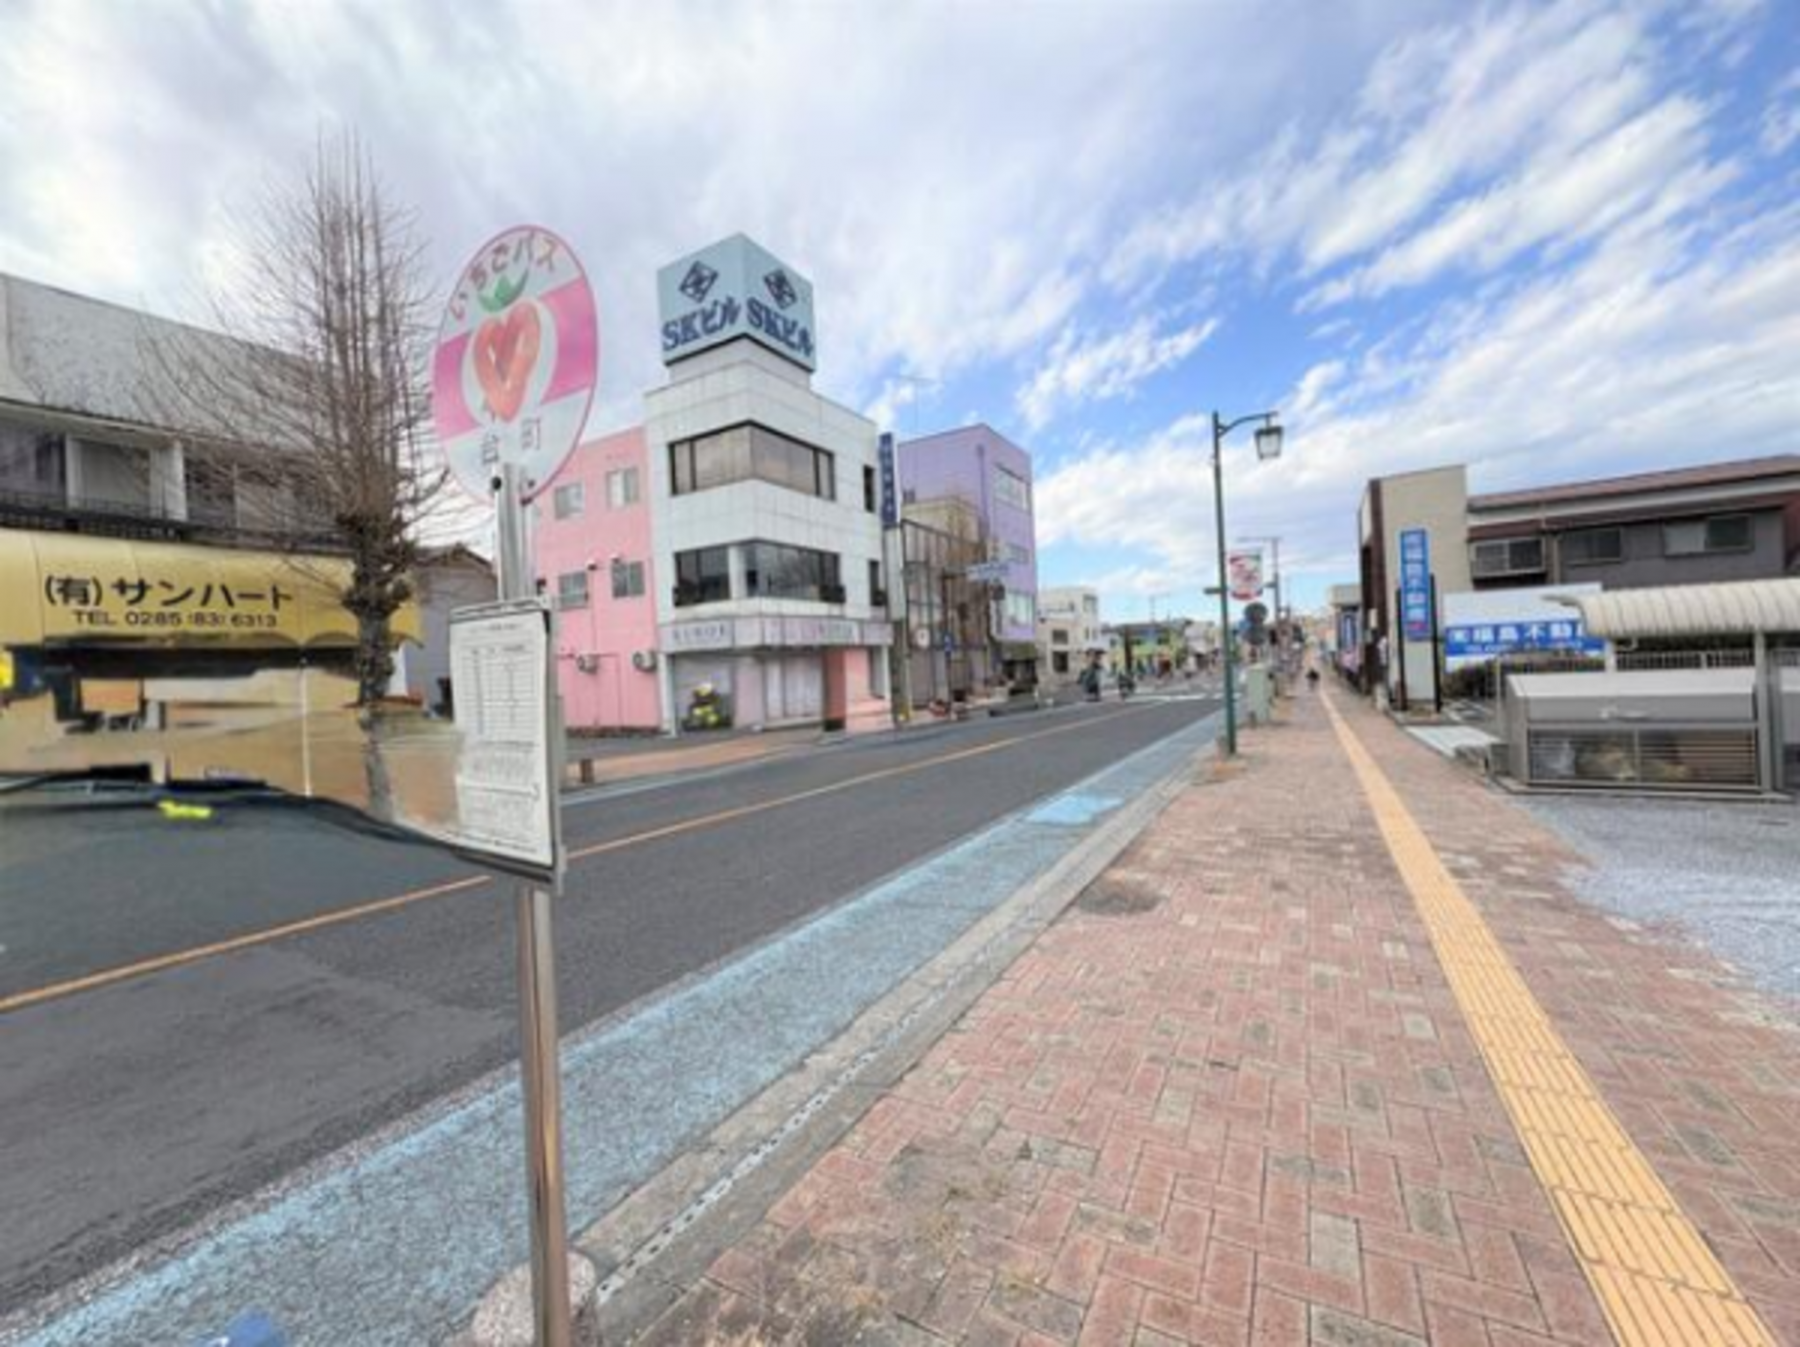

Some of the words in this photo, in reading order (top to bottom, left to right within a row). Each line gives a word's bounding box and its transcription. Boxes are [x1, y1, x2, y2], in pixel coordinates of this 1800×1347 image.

[449, 231, 557, 321] いちごバス
[662, 296, 741, 351] SKビル
[747, 297, 813, 357] SKビル
[72, 611, 117, 625] TEL
